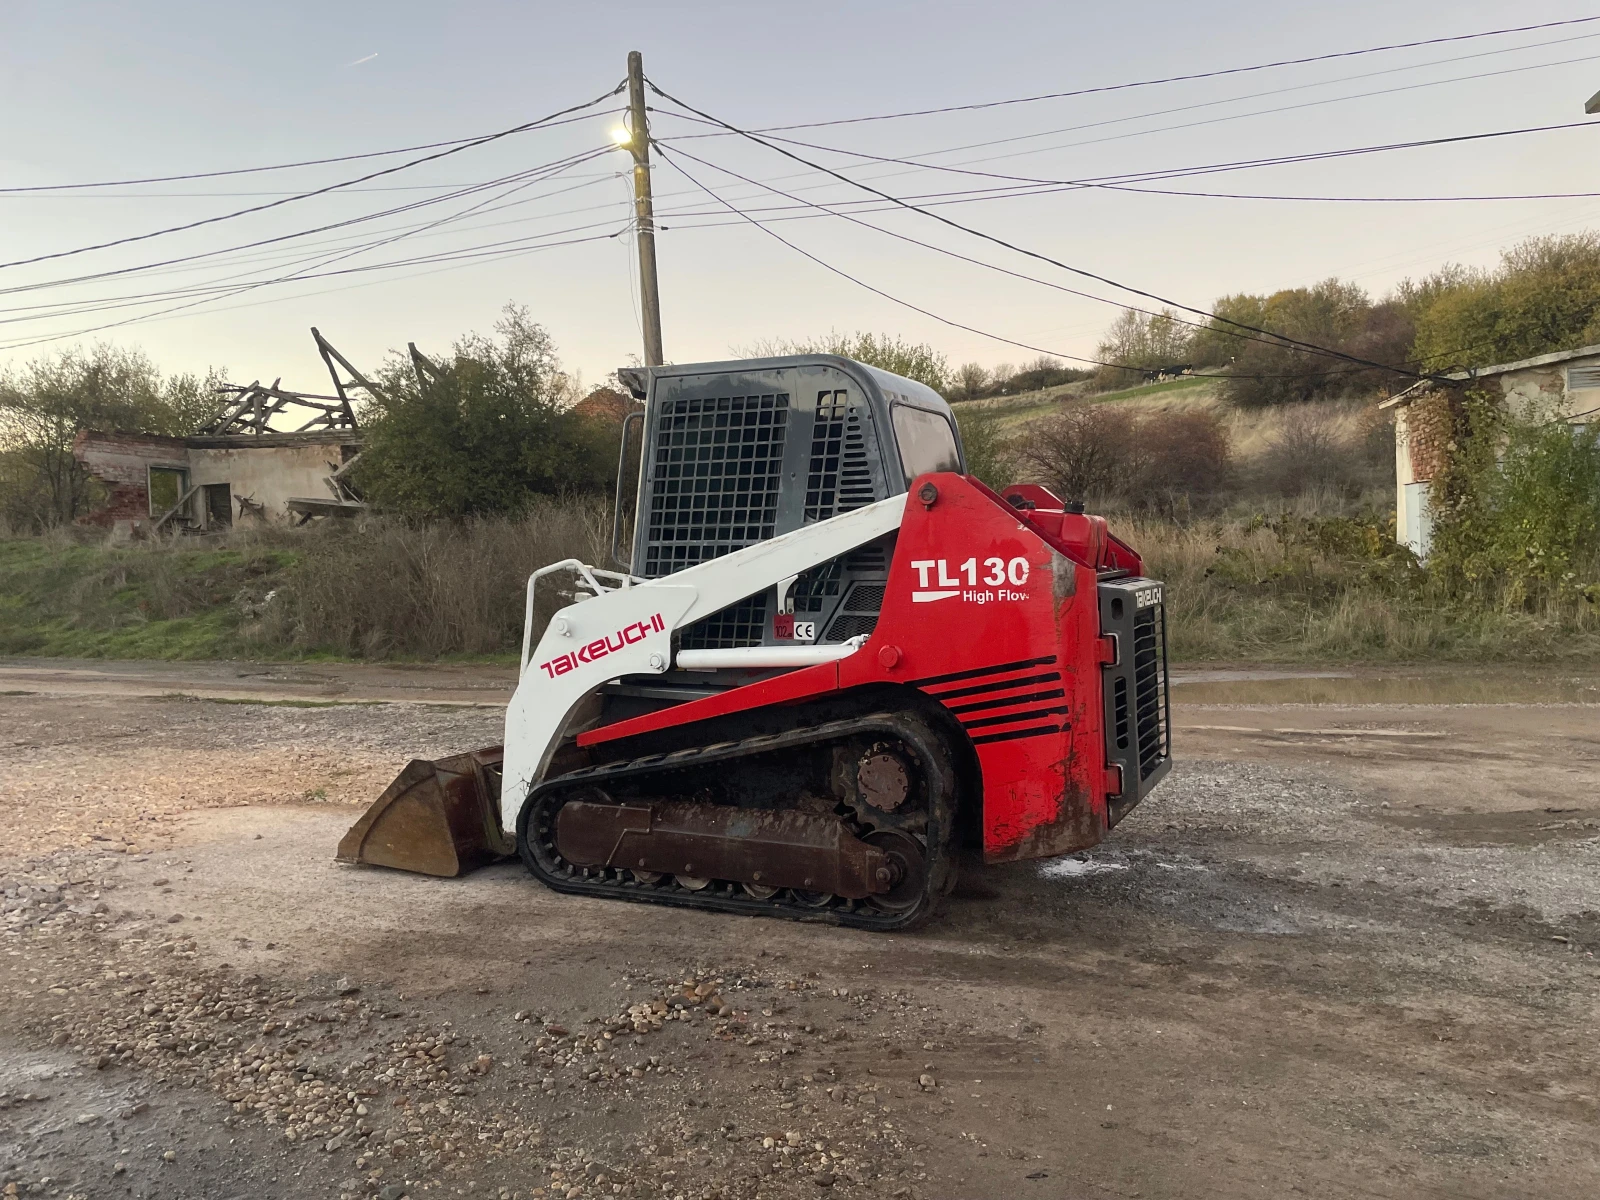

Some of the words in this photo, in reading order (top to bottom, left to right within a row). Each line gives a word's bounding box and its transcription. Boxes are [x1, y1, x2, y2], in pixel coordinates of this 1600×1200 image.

[911, 557, 1029, 587] TL130
[963, 590, 993, 604] High
[1135, 587, 1161, 608] TAKEUCH
[540, 613, 665, 678] TAKEUCHI
